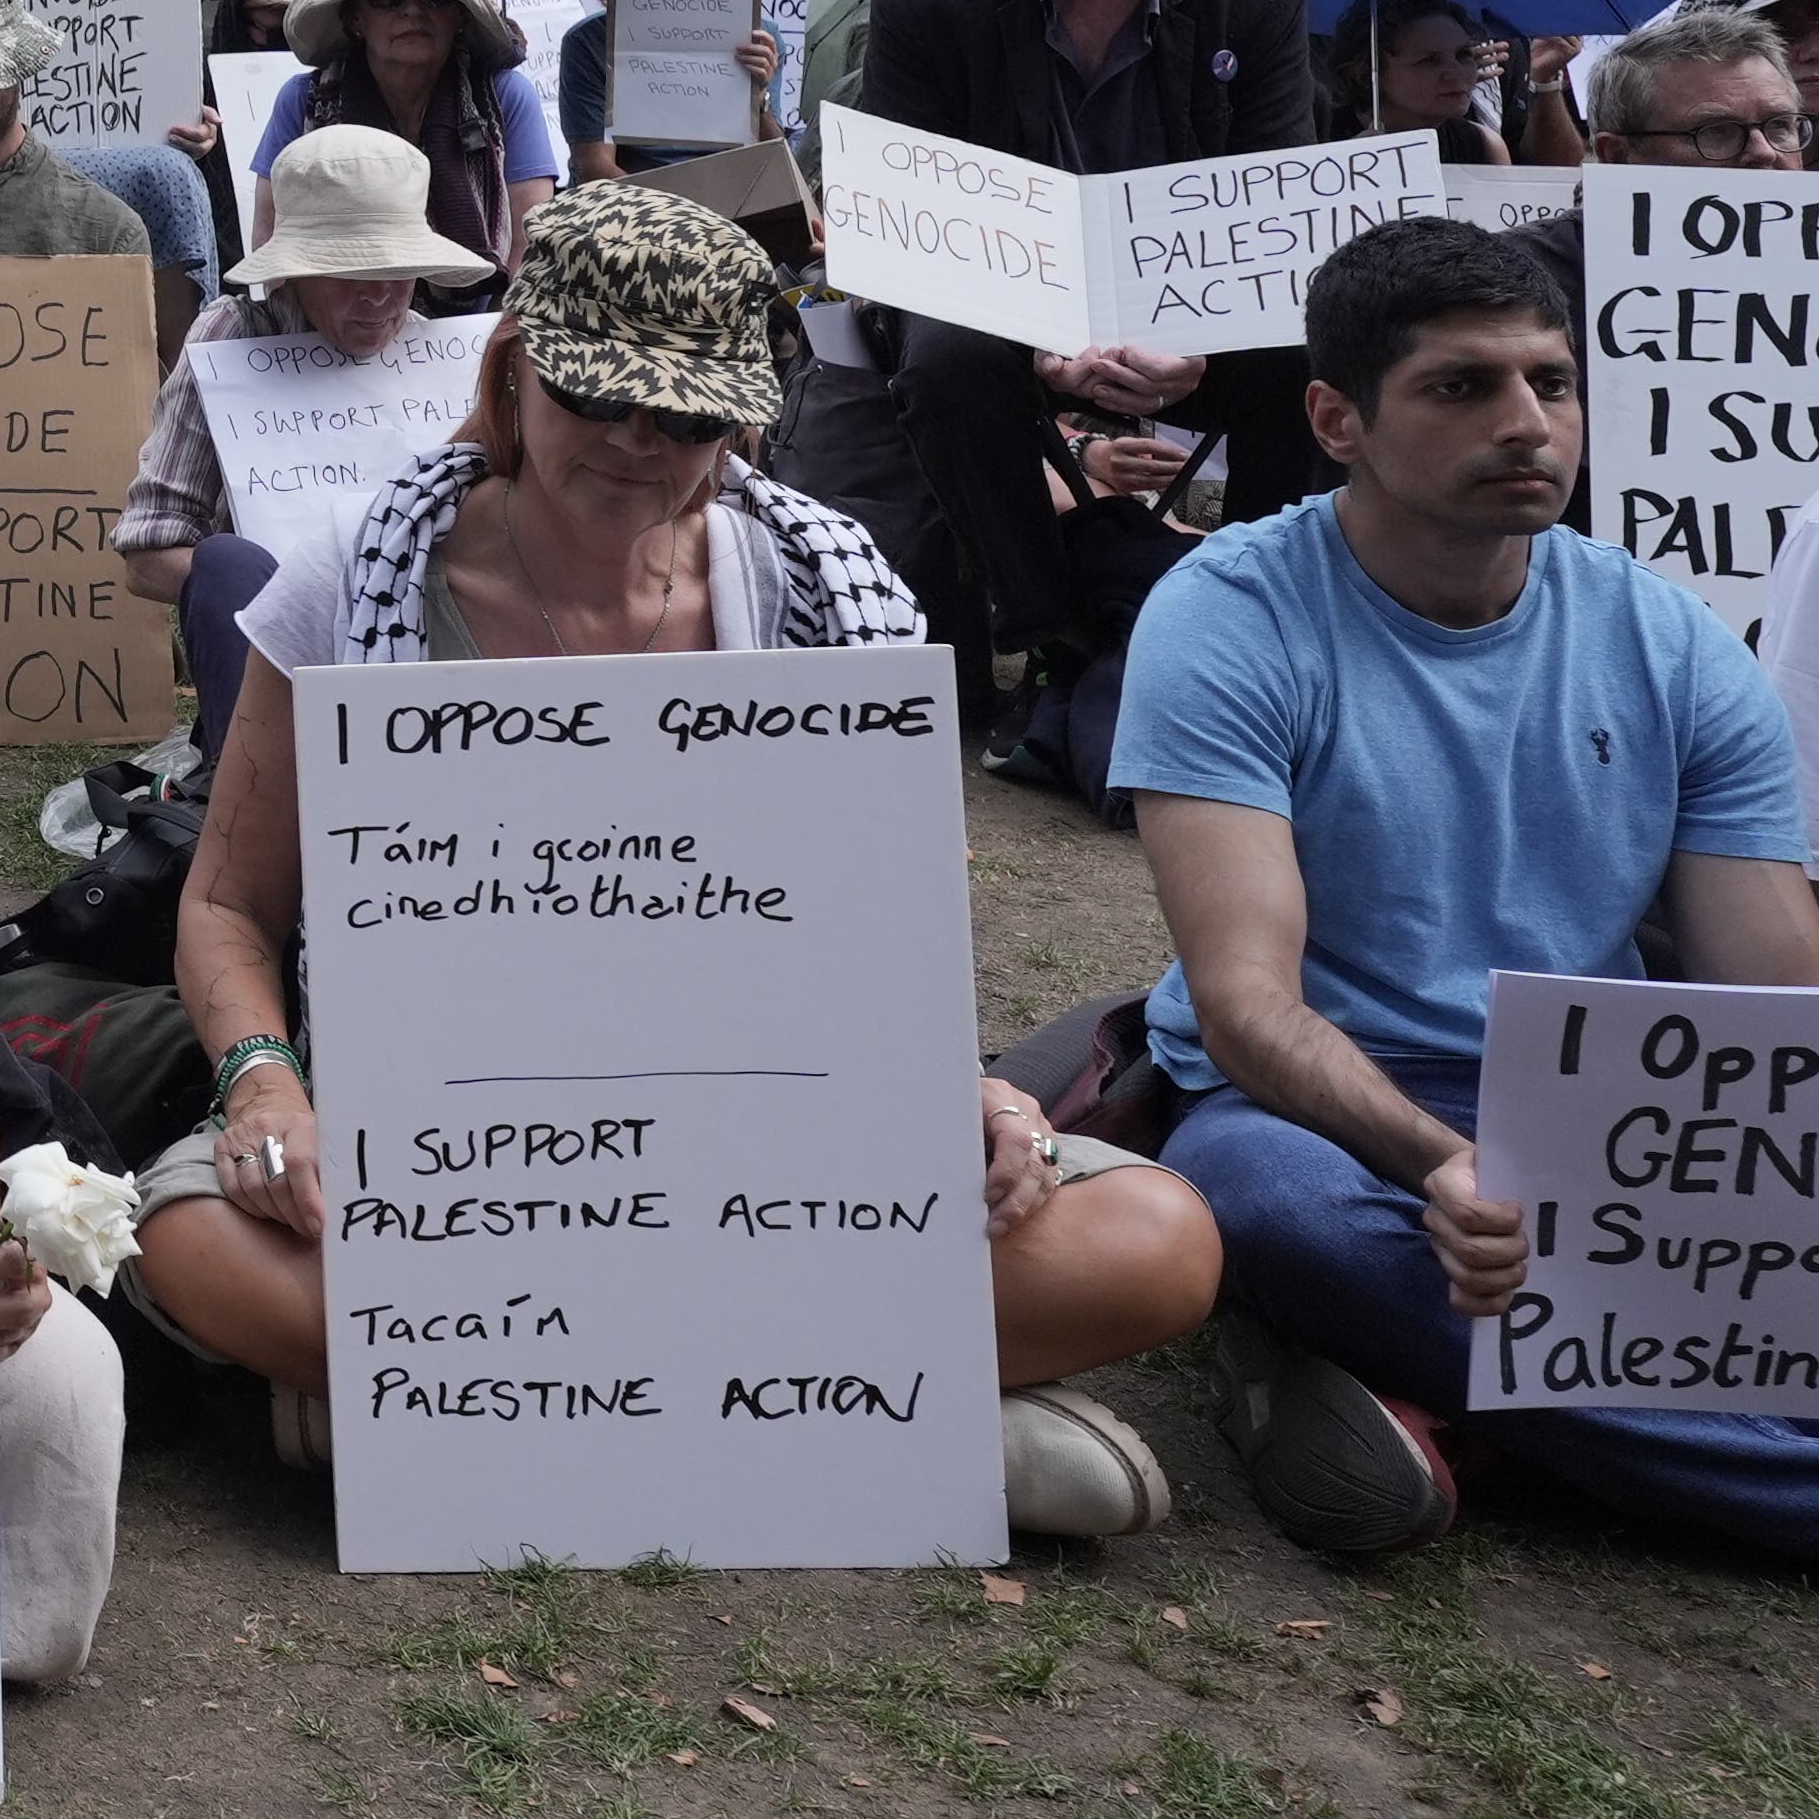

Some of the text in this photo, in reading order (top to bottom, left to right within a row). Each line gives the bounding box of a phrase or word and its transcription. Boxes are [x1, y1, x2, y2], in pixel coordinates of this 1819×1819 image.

[47, 15, 144, 57] PPORT
[648, 26, 732, 42] SUPPORT
[20, 52, 148, 100] LESTINE
[627, 57, 735, 77] PALESTINE
[647, 80, 710, 98] ACTION
[30, 94, 142, 136] ACTION
[837, 120, 1055, 214] I OPPOSE
[1123, 141, 1429, 224] I SUPPORT
[823, 183, 1069, 291] GENOCIDE
[1632, 192, 1651, 257] I
[206, 351, 218, 381] I
[226, 414, 239, 440] I
[255, 403, 385, 435] SUPPORT
[1649, 387, 1670, 457] I
[249, 460, 368, 495] ACTION.
[336, 696, 936, 765] I OPPOSE GENOCIDE
[490, 823, 501, 861] i
[534, 823, 698, 892] gcoinne
[1559, 1004, 1587, 1075] I
[356, 1117, 657, 1191] I SUPPORT
[1605, 1106, 1819, 1199] GEN
[342, 1192, 938, 1243] PALESTINE ACTION
[1537, 1201, 1559, 1257] I
[371, 1367, 924, 1424] PALESTINE ACTION
